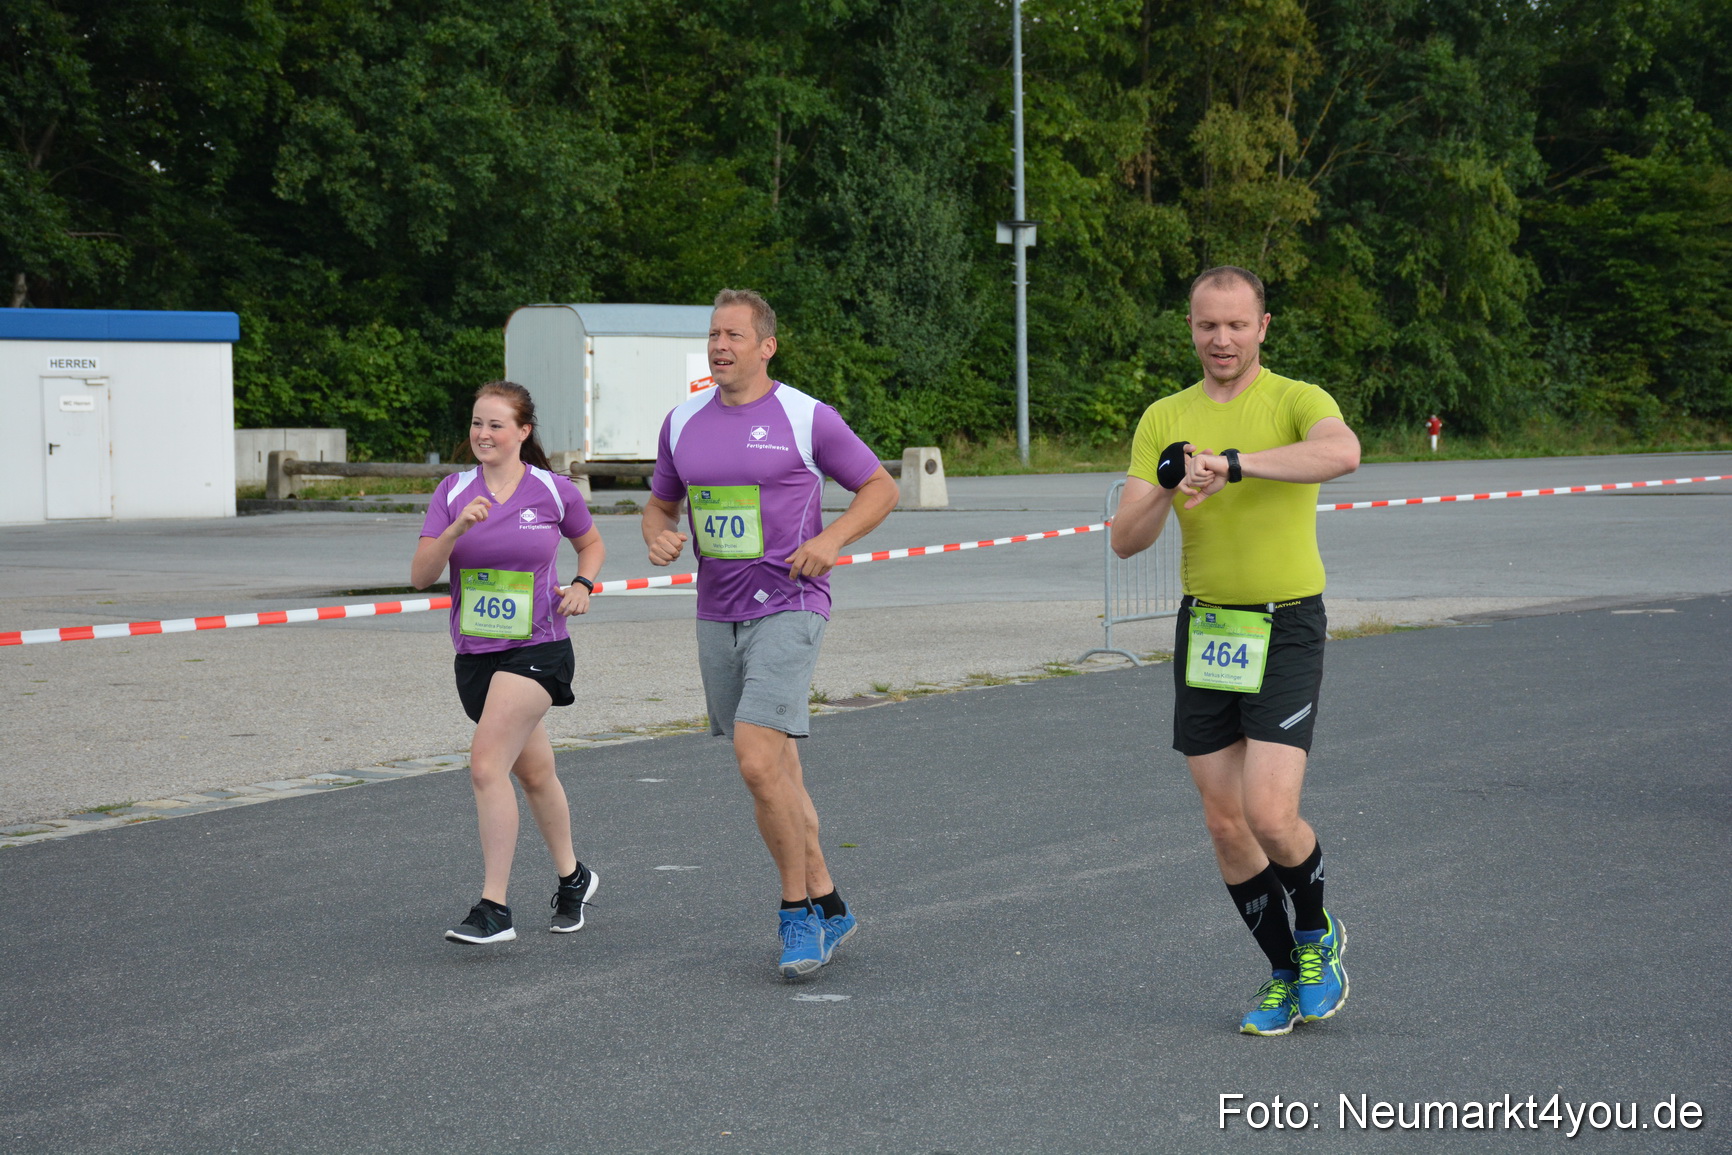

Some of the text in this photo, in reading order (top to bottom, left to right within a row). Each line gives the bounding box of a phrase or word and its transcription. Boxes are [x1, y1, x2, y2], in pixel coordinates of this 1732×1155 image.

[50, 359, 96, 368] HERREN
[705, 515, 745, 538] 470
[473, 595, 516, 620] 469
[1201, 640, 1249, 669] 464
